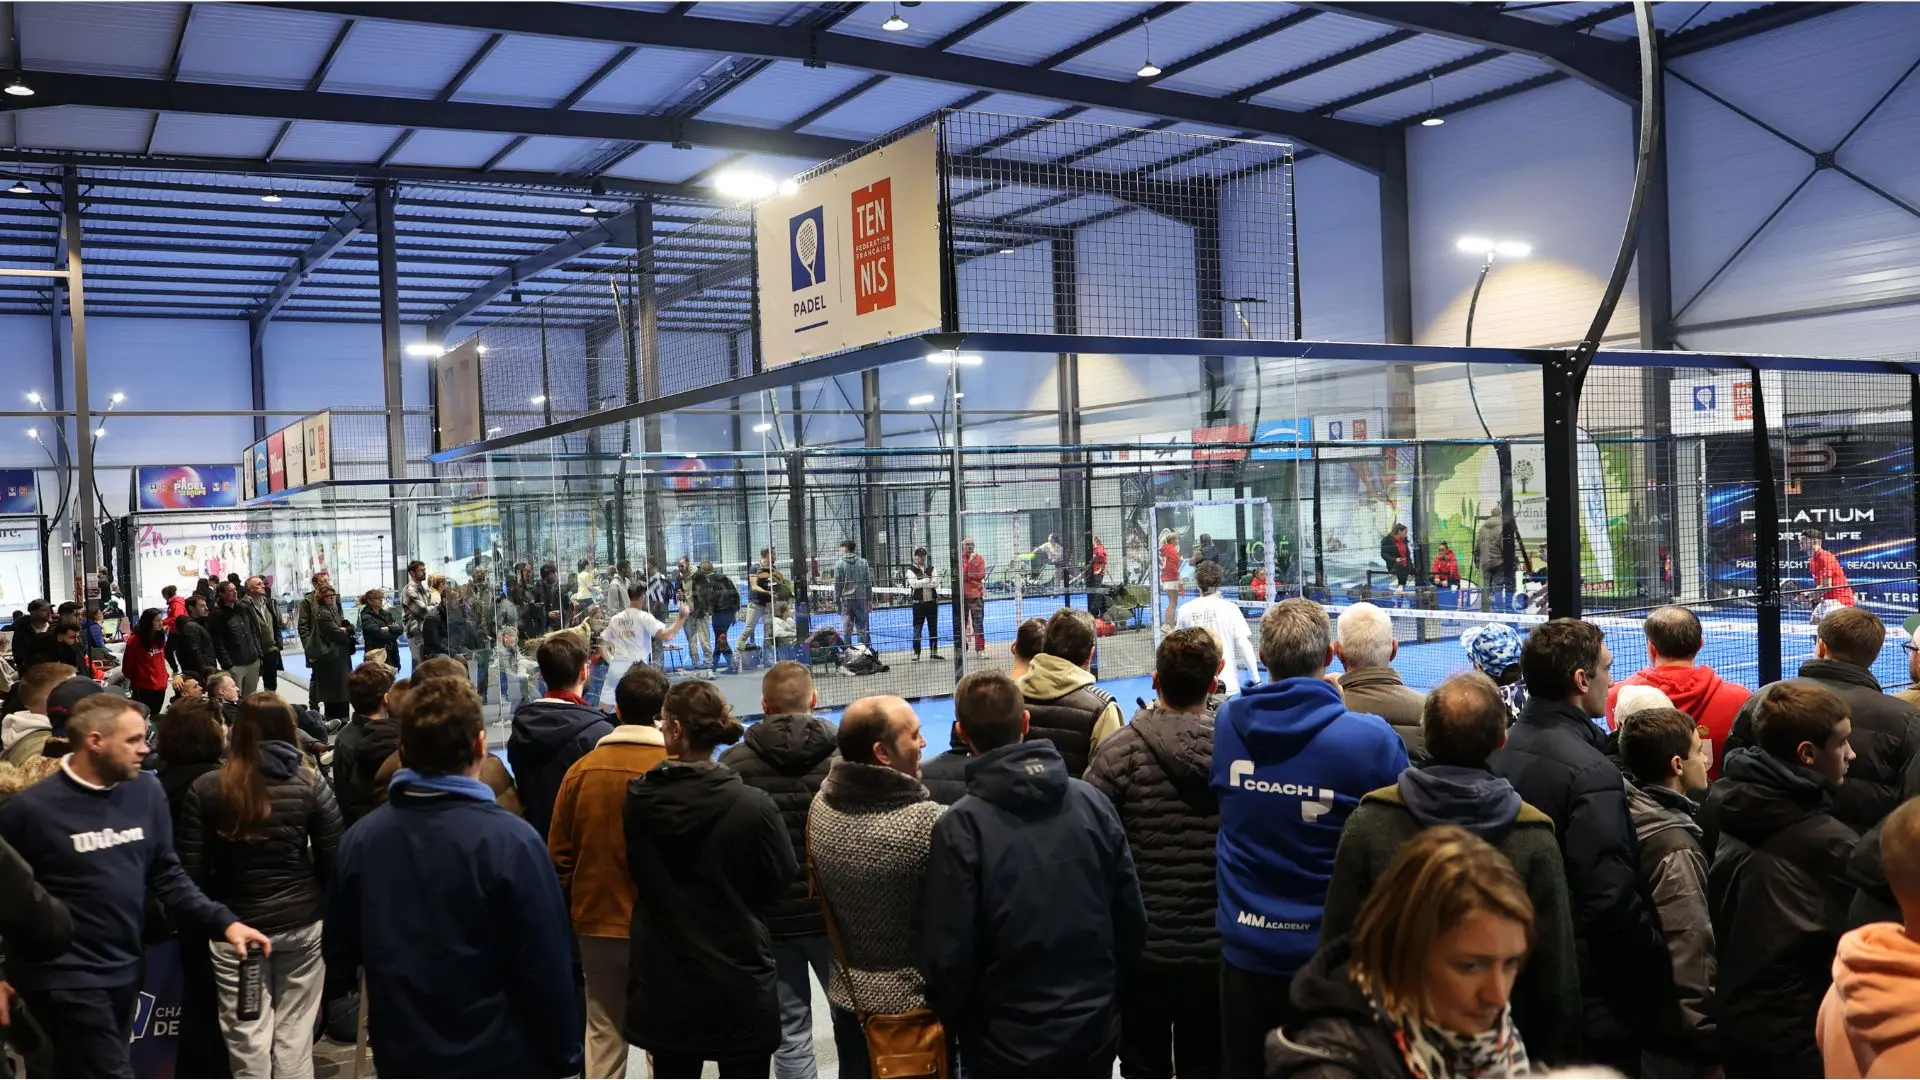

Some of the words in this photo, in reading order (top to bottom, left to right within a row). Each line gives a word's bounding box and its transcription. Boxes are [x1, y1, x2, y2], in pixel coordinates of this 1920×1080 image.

[856, 198, 886, 239] TEN
[860, 257, 889, 297] NIS
[793, 295, 827, 317] PADEL
[1741, 507, 1875, 524] PLATIUM
[210, 532, 241, 541] notre
[1824, 531, 1862, 541] LIFE
[1778, 561, 1803, 569] EACH
[1847, 560, 1880, 570] BEACH
[1244, 779, 1313, 797] COACH
[69, 827, 145, 853] Wilson
